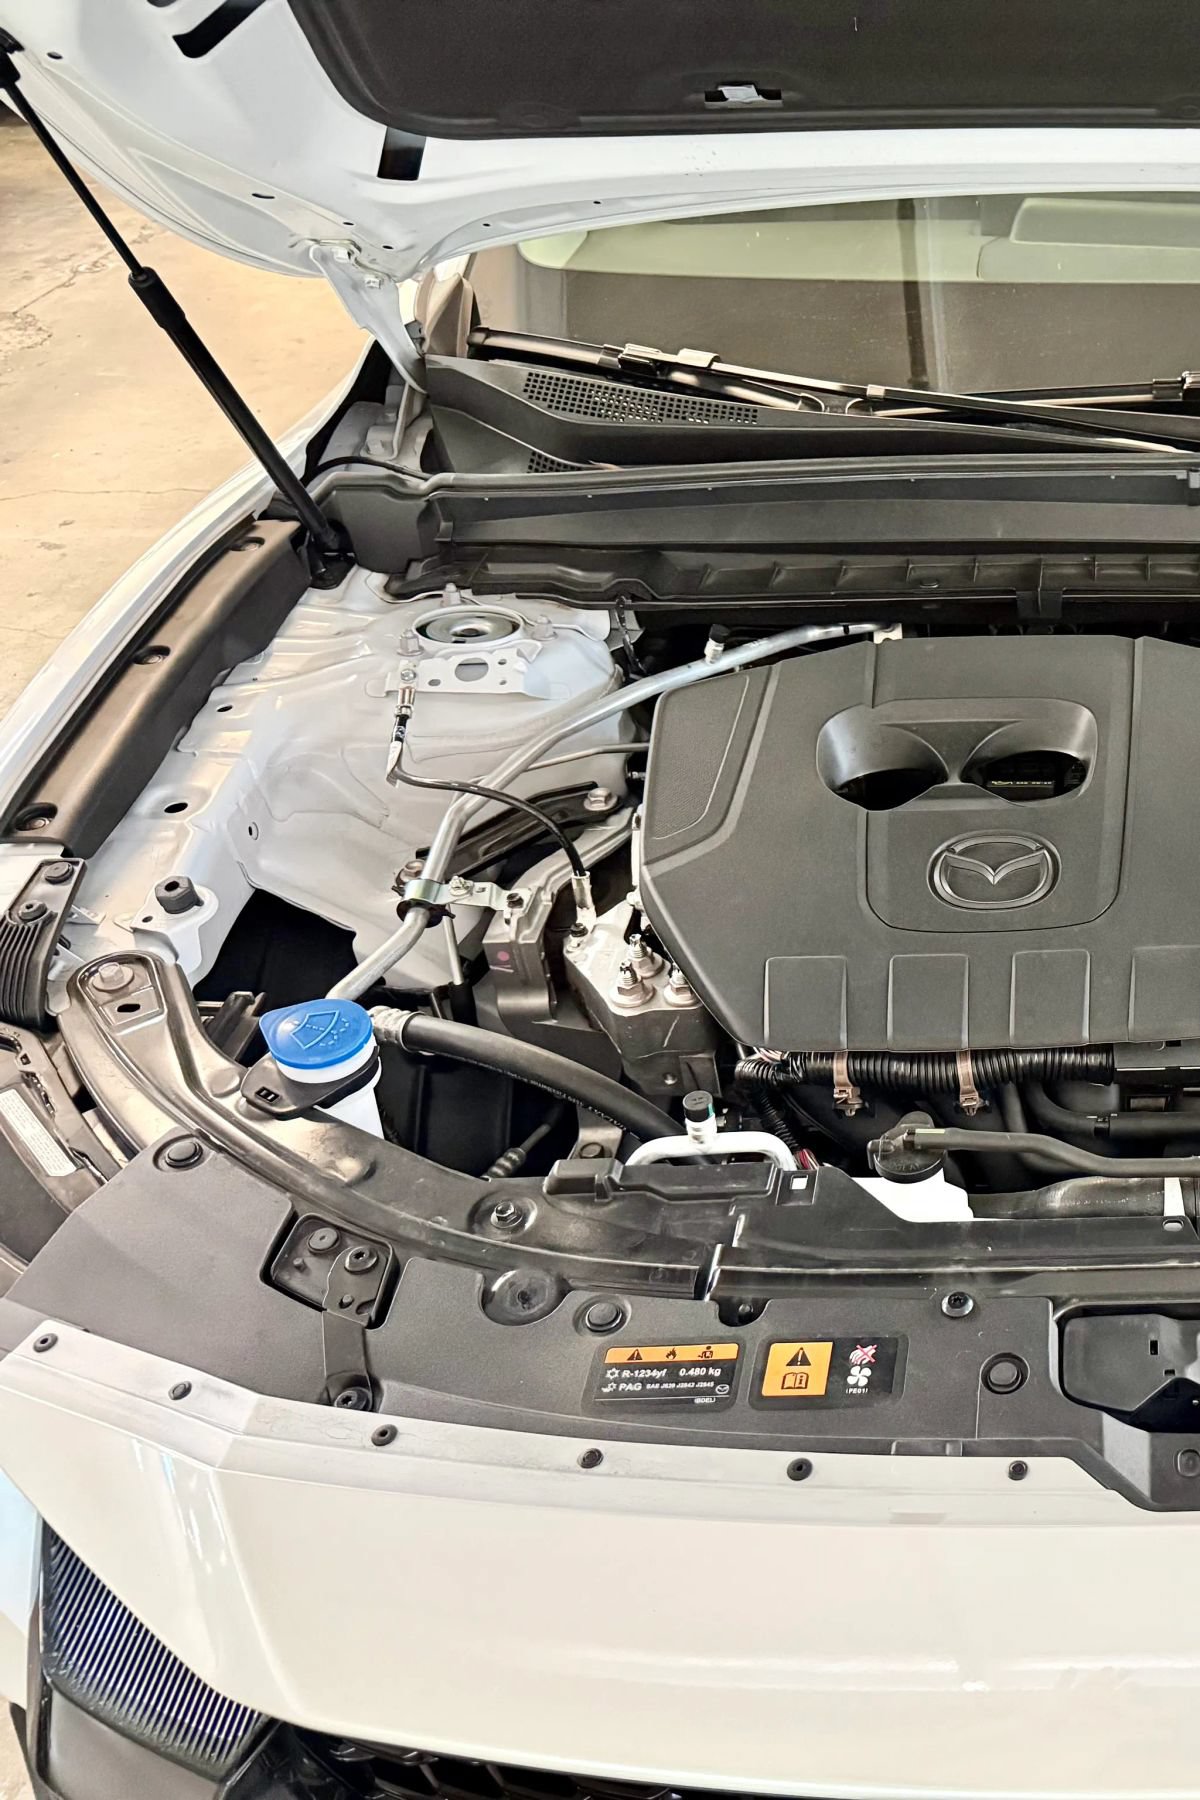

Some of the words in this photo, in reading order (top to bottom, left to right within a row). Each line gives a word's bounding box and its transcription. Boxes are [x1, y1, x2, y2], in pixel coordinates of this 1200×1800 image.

[621, 1368, 667, 1379] R-1234yf
[679, 1367, 707, 1377] 0.480
[708, 1367, 722, 1377] kg
[618, 1382, 642, 1392] PAG
[646, 1382, 660, 1390] SAE
